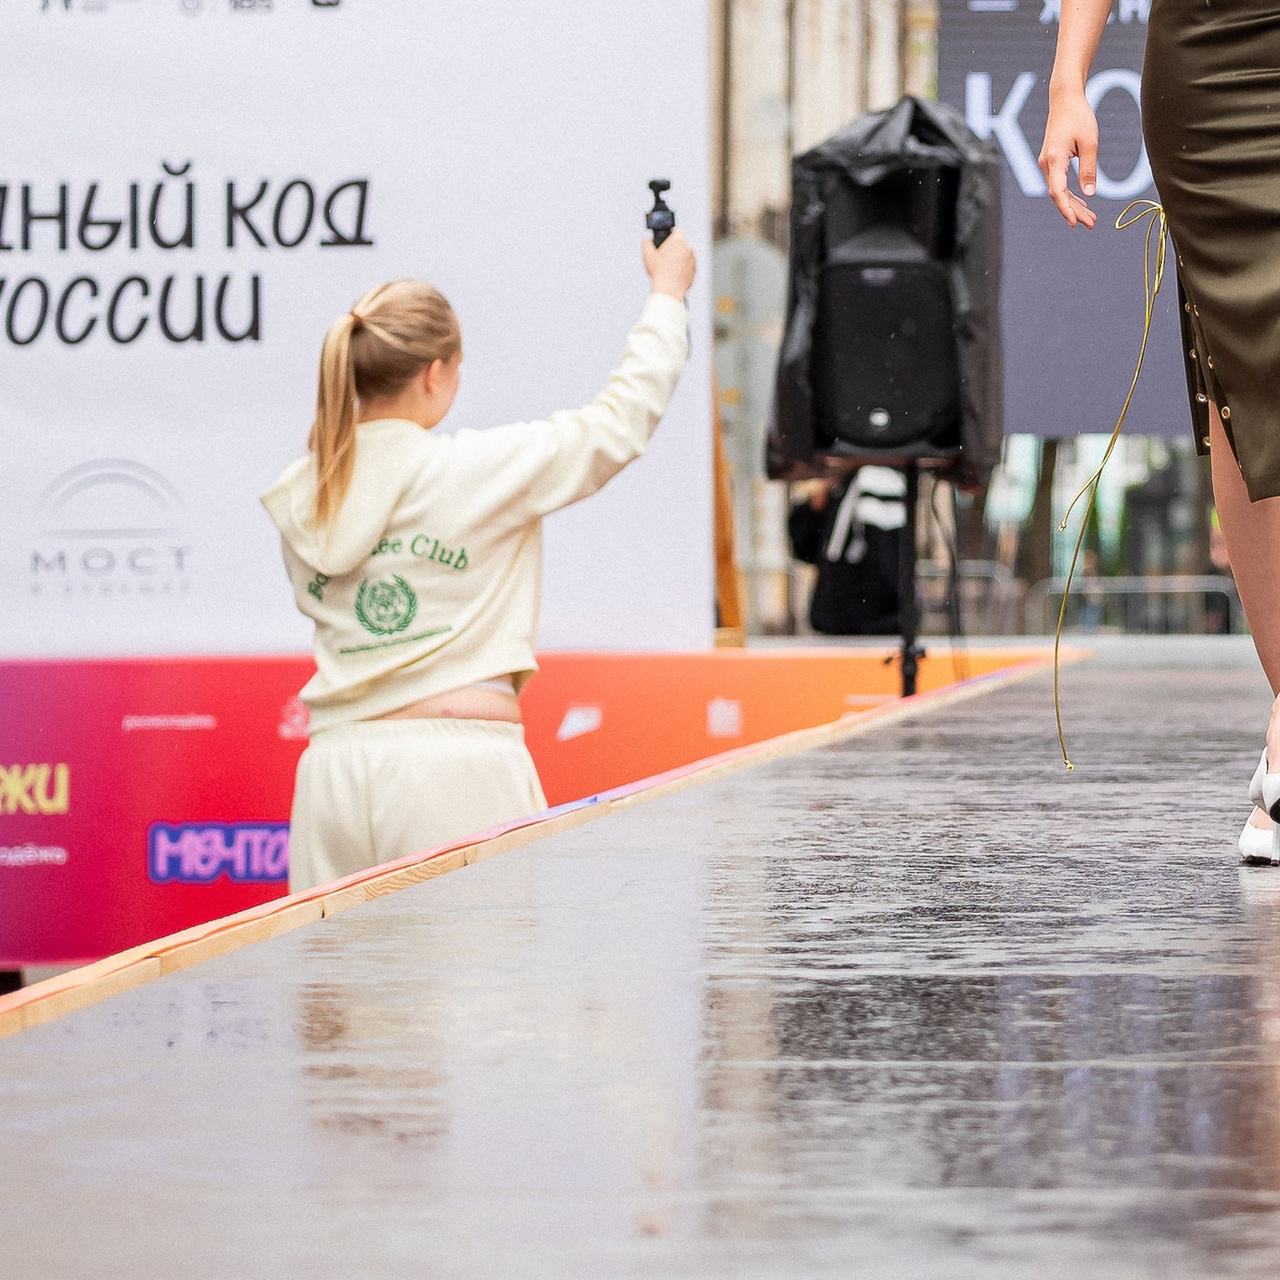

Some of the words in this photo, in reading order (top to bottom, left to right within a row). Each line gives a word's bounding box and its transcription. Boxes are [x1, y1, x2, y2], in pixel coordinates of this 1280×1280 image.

[0, 161, 197, 251] НЫЙ
[226, 179, 374, 249] КОД
[0, 273, 261, 346] ОССИИ
[31, 546, 193, 577] МОСТ
[410, 533, 469, 571] Club
